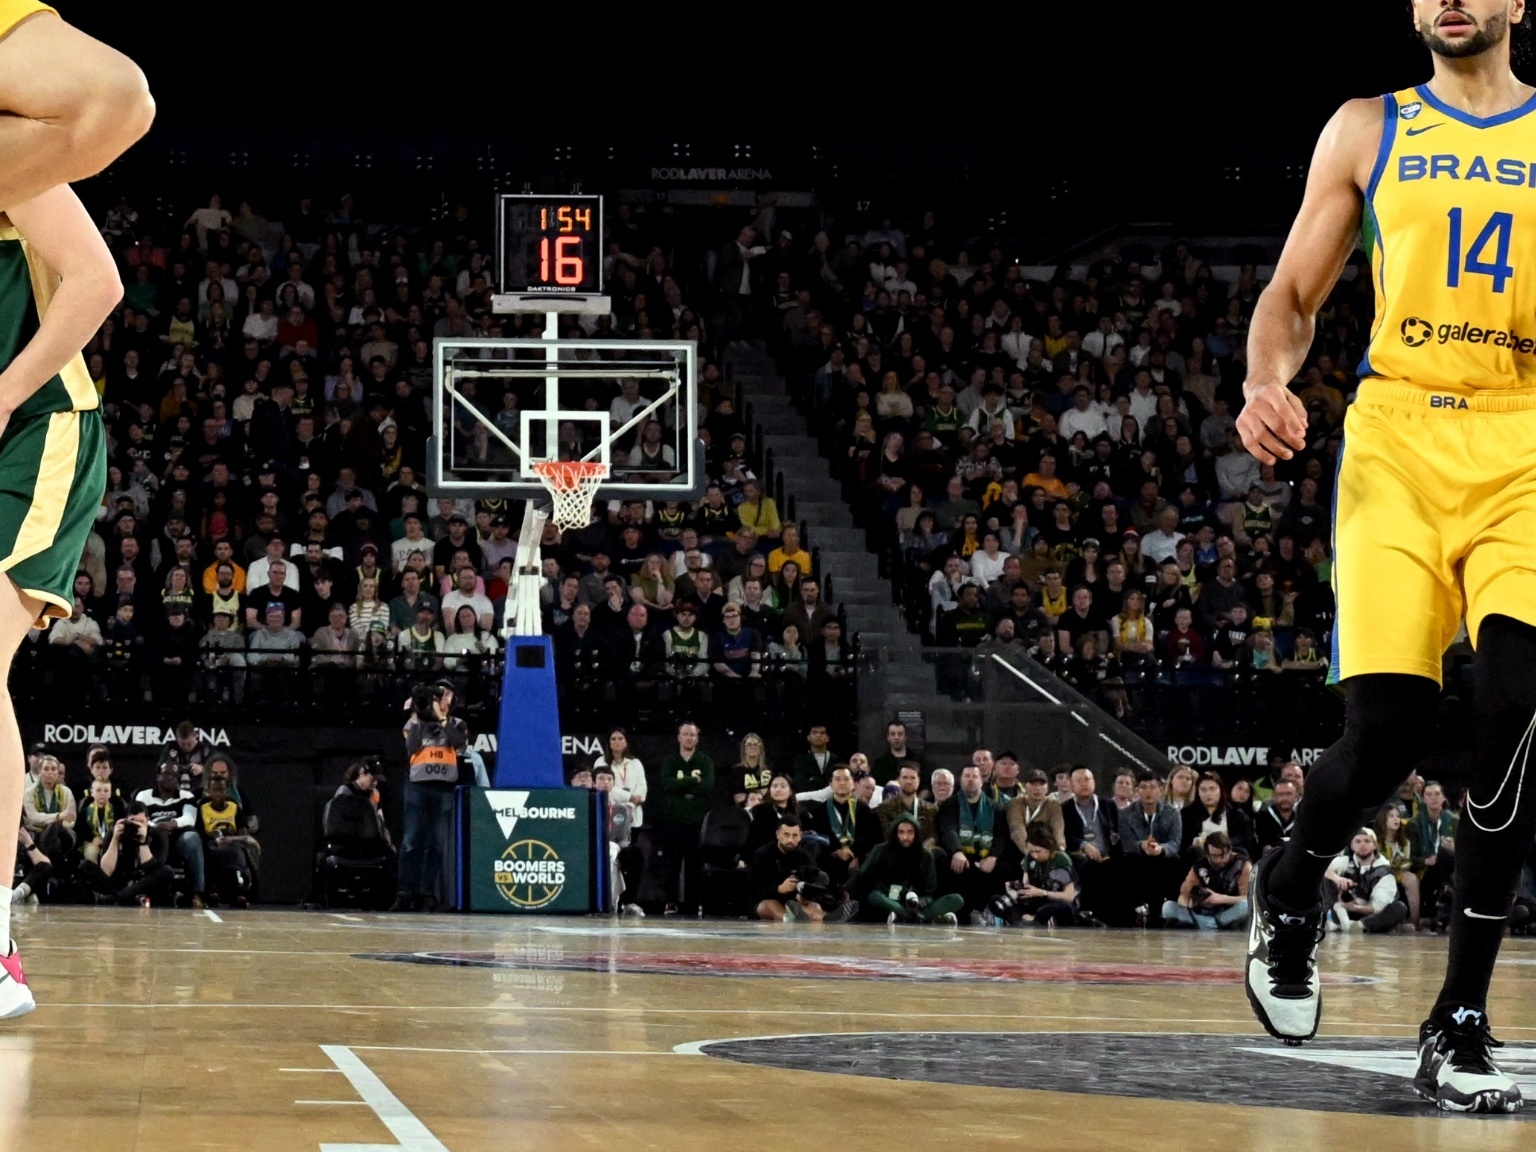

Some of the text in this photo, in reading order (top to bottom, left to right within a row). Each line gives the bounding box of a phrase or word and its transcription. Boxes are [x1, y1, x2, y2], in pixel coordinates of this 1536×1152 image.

[1447, 207, 1514, 293] 14
[540, 235, 583, 285] 16
[1430, 395, 1469, 410] BRA
[44, 723, 231, 747] RODLAVERANA
[425, 763, 448, 775] 006
[492, 806, 576, 819] MELBOURNE
[494, 860, 566, 873] BOOMERS
[498, 872, 566, 885] VS WORLD
